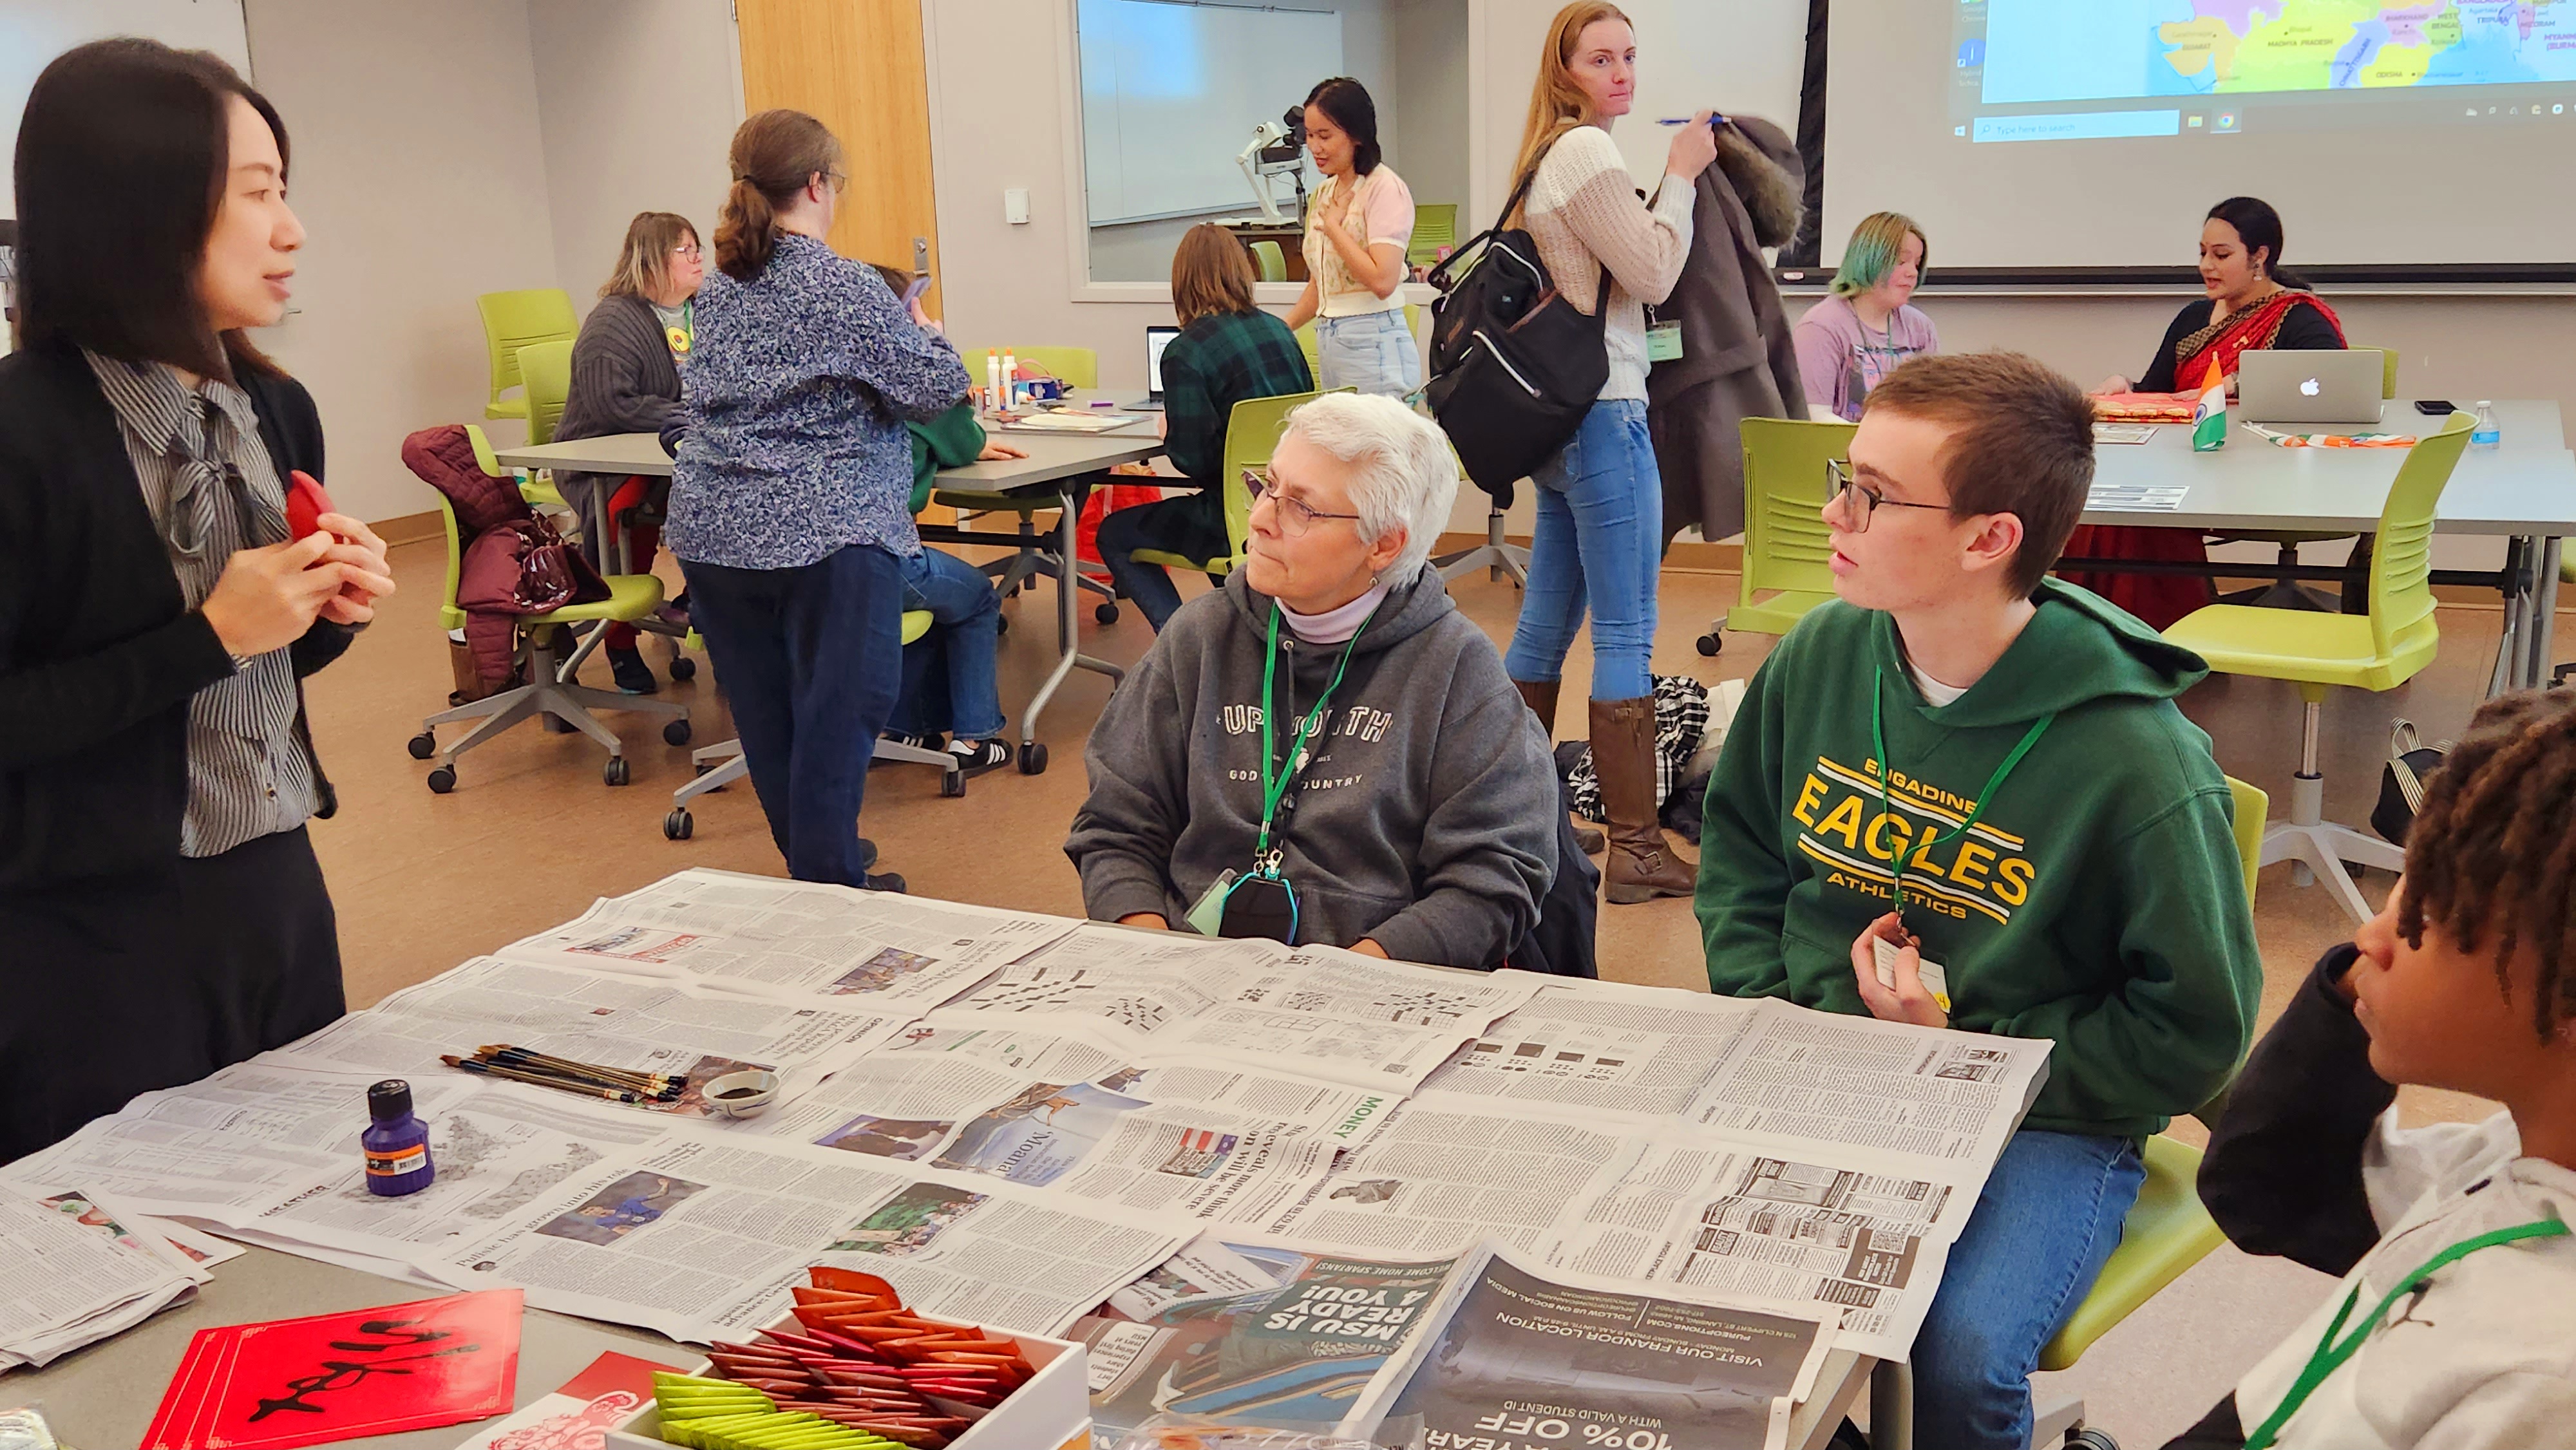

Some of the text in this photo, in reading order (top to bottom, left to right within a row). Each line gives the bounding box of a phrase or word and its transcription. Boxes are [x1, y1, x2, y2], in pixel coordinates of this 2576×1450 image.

[1998, 126, 2016, 135] Type
[1223, 704, 1264, 735] UP
[1864, 757, 1980, 813] ENGADINE
[1792, 773, 2035, 906] EAGLES
[1826, 872, 1967, 919] ATHLETICS
[1938, 995, 1948, 1008] 4
[845, 1017, 884, 1044] OPINION
[1333, 1097, 1384, 1139] MONEY
[1227, 1151, 1250, 1173] will
[1342, 1154, 1353, 1172] win
[1215, 1171, 1233, 1183] be
[1223, 1174, 1252, 1196] more
[1186, 1183, 1220, 1210] severe
[1196, 1194, 1230, 1219] think
[456, 1167, 630, 1267] Pulisic has grown into his role
[1659, 1241, 1673, 1262] TODAY
[1316, 1262, 1455, 1277] WELCOME HOME SPARTANS!
[712, 1301, 744, 1325] Japan
[741, 1288, 772, 1305] beats
[1300, 1285, 1429, 1306] 4 YOU!
[1486, 1277, 1633, 1321] FOLLOW US ON SOCIAL MEDIA
[1283, 1299, 1416, 1323] READY
[1131, 1332, 1148, 1341] MSU
[1264, 1312, 1401, 1341] MSU IS
[1625, 1331, 1653, 1342] FROM
[1646, 1318, 1752, 1342] PUREOPTIONS.COM
[1099, 1340, 1137, 1354] during first
[1122, 1339, 1143, 1348] years
[1495, 1312, 1763, 1368] VISIT OUR FRANDOR LOCATION
[1705, 1343, 1736, 1353] MONDAY
[1090, 1363, 1119, 1375] students
[1106, 1359, 1126, 1368] share
[1503, 1399, 1663, 1429] WITH A VALID STUDENT ID
[1473, 1411, 1674, 1450] 10% OFF
